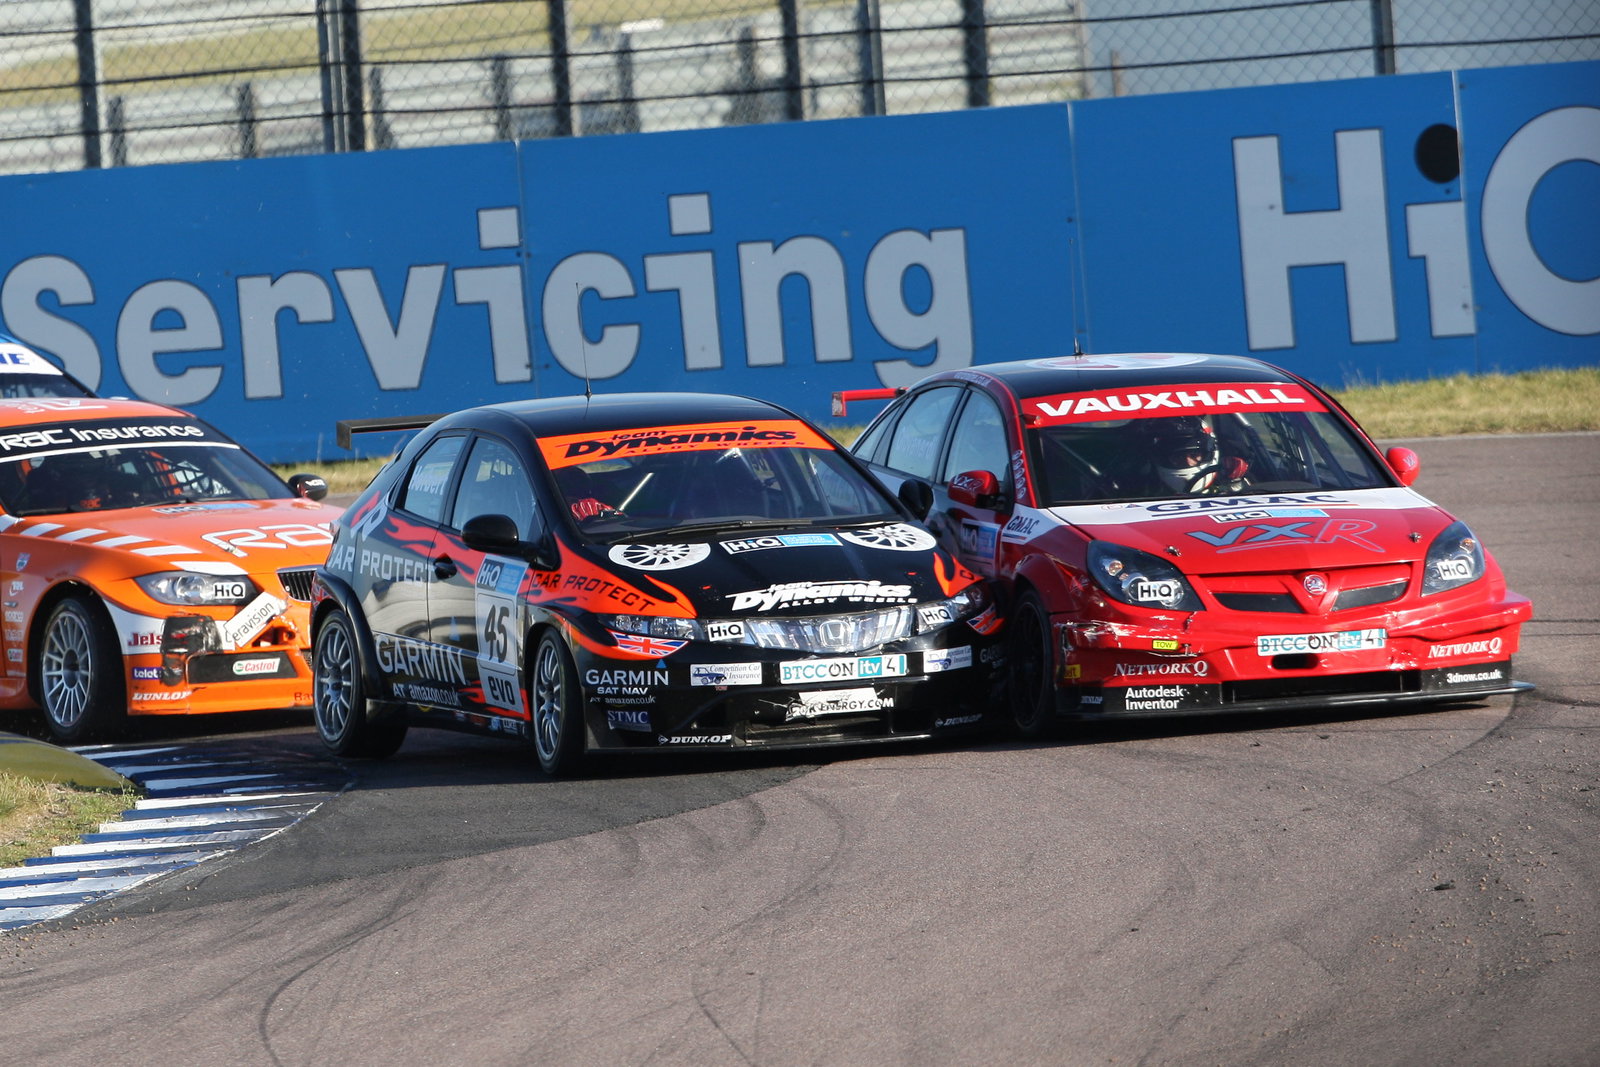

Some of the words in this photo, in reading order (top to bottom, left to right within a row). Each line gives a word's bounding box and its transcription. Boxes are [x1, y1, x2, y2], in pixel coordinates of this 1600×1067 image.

[2, 193, 975, 407] Servicing
[1036, 388, 1305, 417] VAUXHALL
[69, 423, 204, 442] Insurance
[611, 430, 667, 442] team
[564, 425, 797, 459] Dynamics
[1146, 494, 1348, 513] GMAC
[1216, 511, 1267, 522] HiQ
[1006, 515, 1040, 535] GMAC
[1185, 518, 1386, 553] VXR
[727, 538, 782, 552] HiQ
[327, 543, 356, 573] CAR
[360, 549, 436, 590] PROTECT
[1441, 562, 1468, 577] HiQ
[477, 562, 501, 588] HiQ
[214, 583, 244, 598] HiQ
[531, 573, 562, 589] CAR
[563, 575, 656, 612] PROTECT
[729, 580, 913, 612] Dynamics
[1139, 582, 1173, 599] HiQ
[777, 597, 838, 610] ALLOY
[923, 608, 952, 622] HiQ
[484, 604, 510, 664] 45
[709, 623, 742, 639] HiQ
[127, 632, 163, 647] Jels
[1155, 641, 1173, 649] TOW
[244, 660, 277, 672] Castrol
[375, 632, 467, 686] GARMIN
[133, 669, 162, 679] telet
[709, 664, 747, 673] Competition
[748, 663, 760, 671] Car
[859, 659, 881, 675] itv
[585, 668, 669, 686] GARMIN
[728, 672, 761, 680] Insurance
[1446, 669, 1503, 684] 3dnow.co.uk
[132, 690, 193, 701] DUNLOP
[393, 683, 405, 699] AT
[487, 675, 516, 705] evo
[597, 686, 619, 695] SAT
[621, 687, 649, 695] NAV
[1125, 685, 1184, 699] Autodesk
[604, 695, 657, 705] amazon.co.uk
[1125, 699, 1180, 711] Inventor
[607, 710, 649, 724] STMC
[669, 734, 732, 744] DUNLOP
